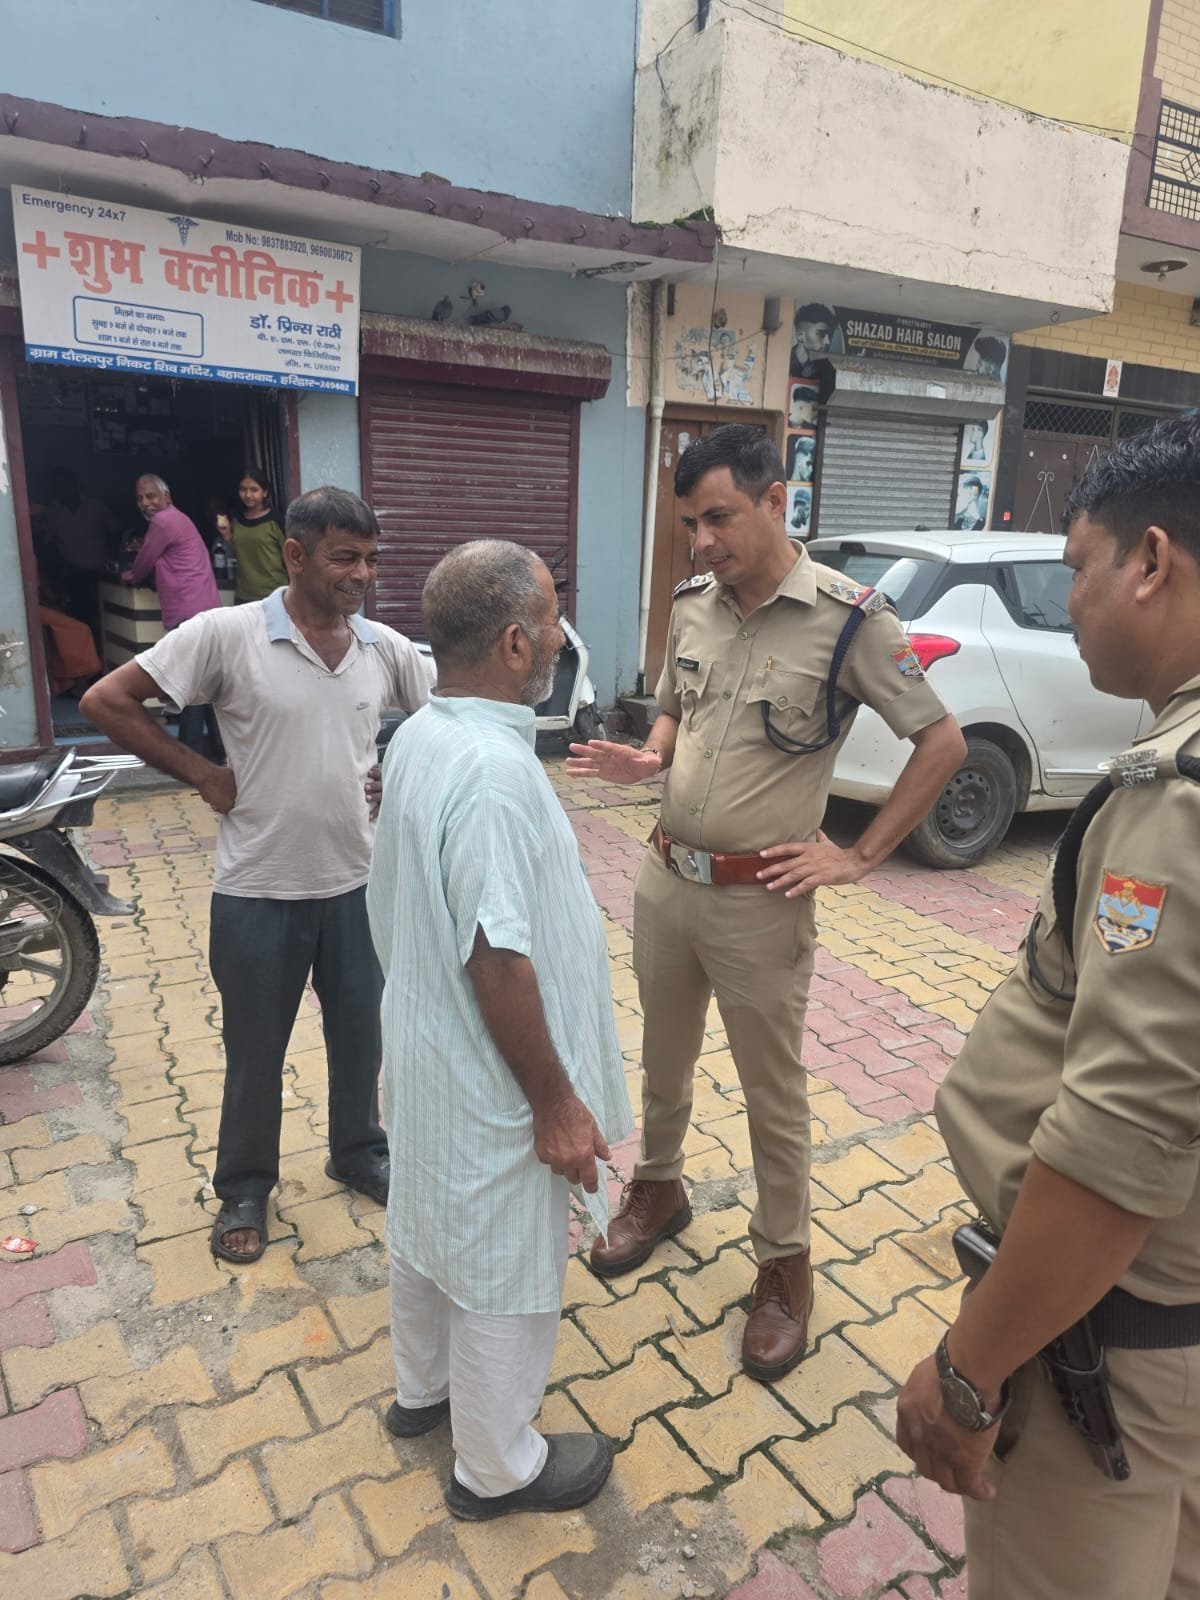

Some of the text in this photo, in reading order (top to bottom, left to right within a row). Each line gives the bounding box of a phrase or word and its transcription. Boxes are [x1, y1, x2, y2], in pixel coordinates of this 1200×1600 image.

[22, 193, 126, 222] Emergency 24x7
[226, 229, 244, 244] Mob
[245, 233, 260, 246] No:
[64, 230, 324, 308] शुभ क्लीनिक
[250, 314, 342, 339] डॉ. प्रिन्स राठी
[846, 320, 893, 341] SHAZAD
[896, 327, 924, 345] HAIR
[927, 332, 962, 351] SALON
[30, 347, 58, 360] ग्राम
[116, 355, 152, 370] निकट
[154, 360, 178, 373] शिव
